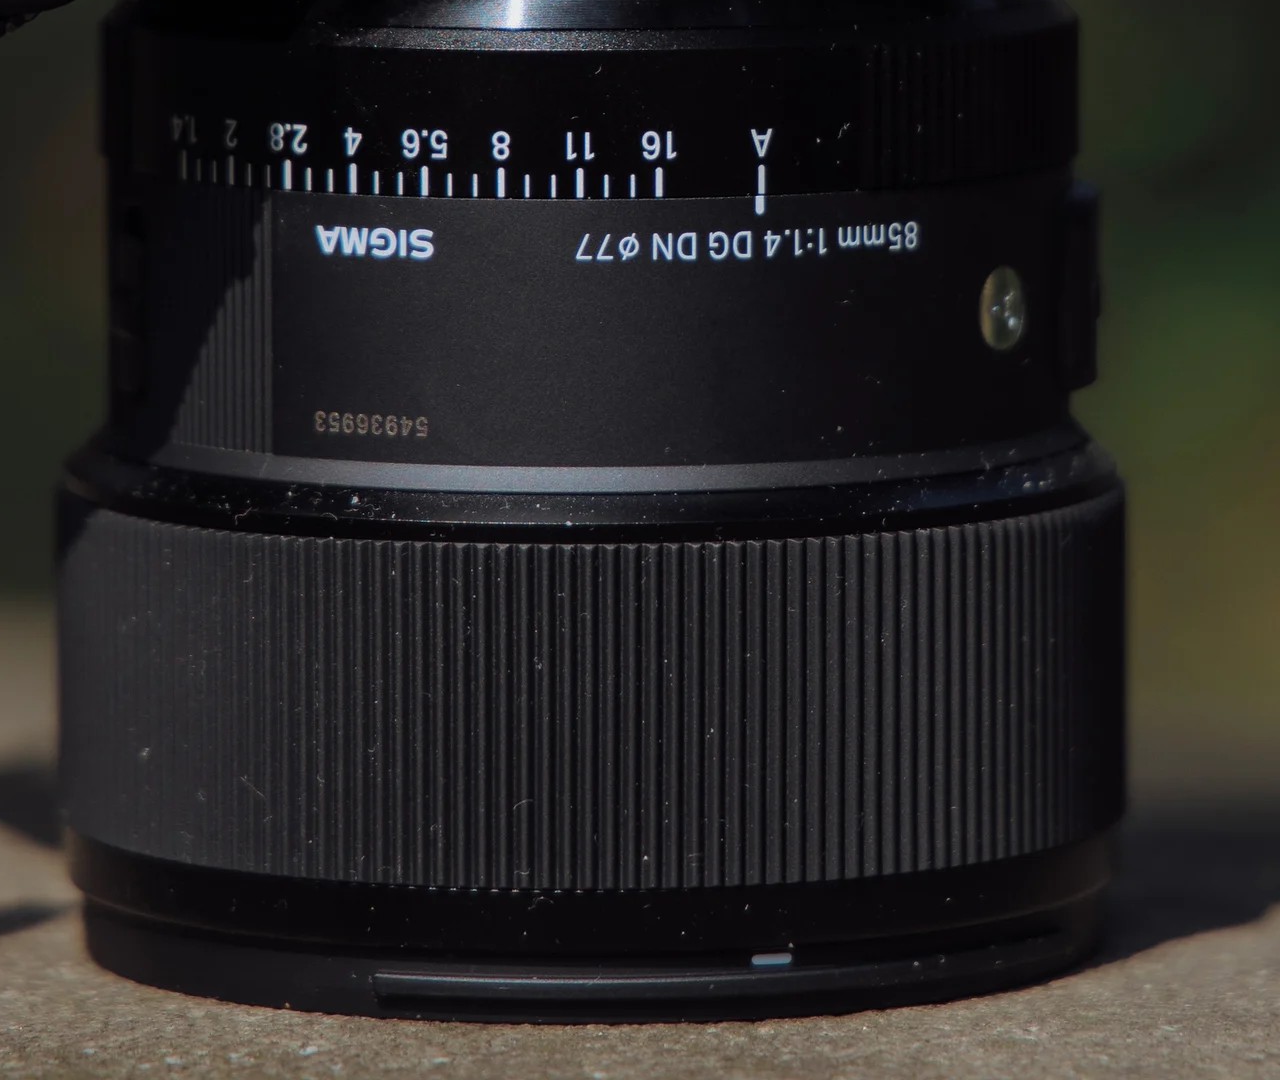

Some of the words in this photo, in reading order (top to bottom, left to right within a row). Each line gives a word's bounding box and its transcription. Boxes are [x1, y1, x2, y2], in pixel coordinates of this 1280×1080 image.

[170, 114, 199, 143] 1.4
[224, 119, 241, 146] 2
[269, 123, 308, 155] 2.8
[343, 126, 363, 156] 4
[751, 128, 773, 157] A
[402, 129, 448, 159] 5.6
[492, 131, 511, 159] 8
[565, 132, 596, 160] 11
[643, 131, 677, 160] 16
[314, 225, 434, 259] SIGMA
[652, 231, 697, 261] DN
[708, 230, 752, 260] DG
[764, 228, 827, 257] 1:1.4
[838, 221, 919, 251] 85mm
[314, 409, 428, 437] 54936953
